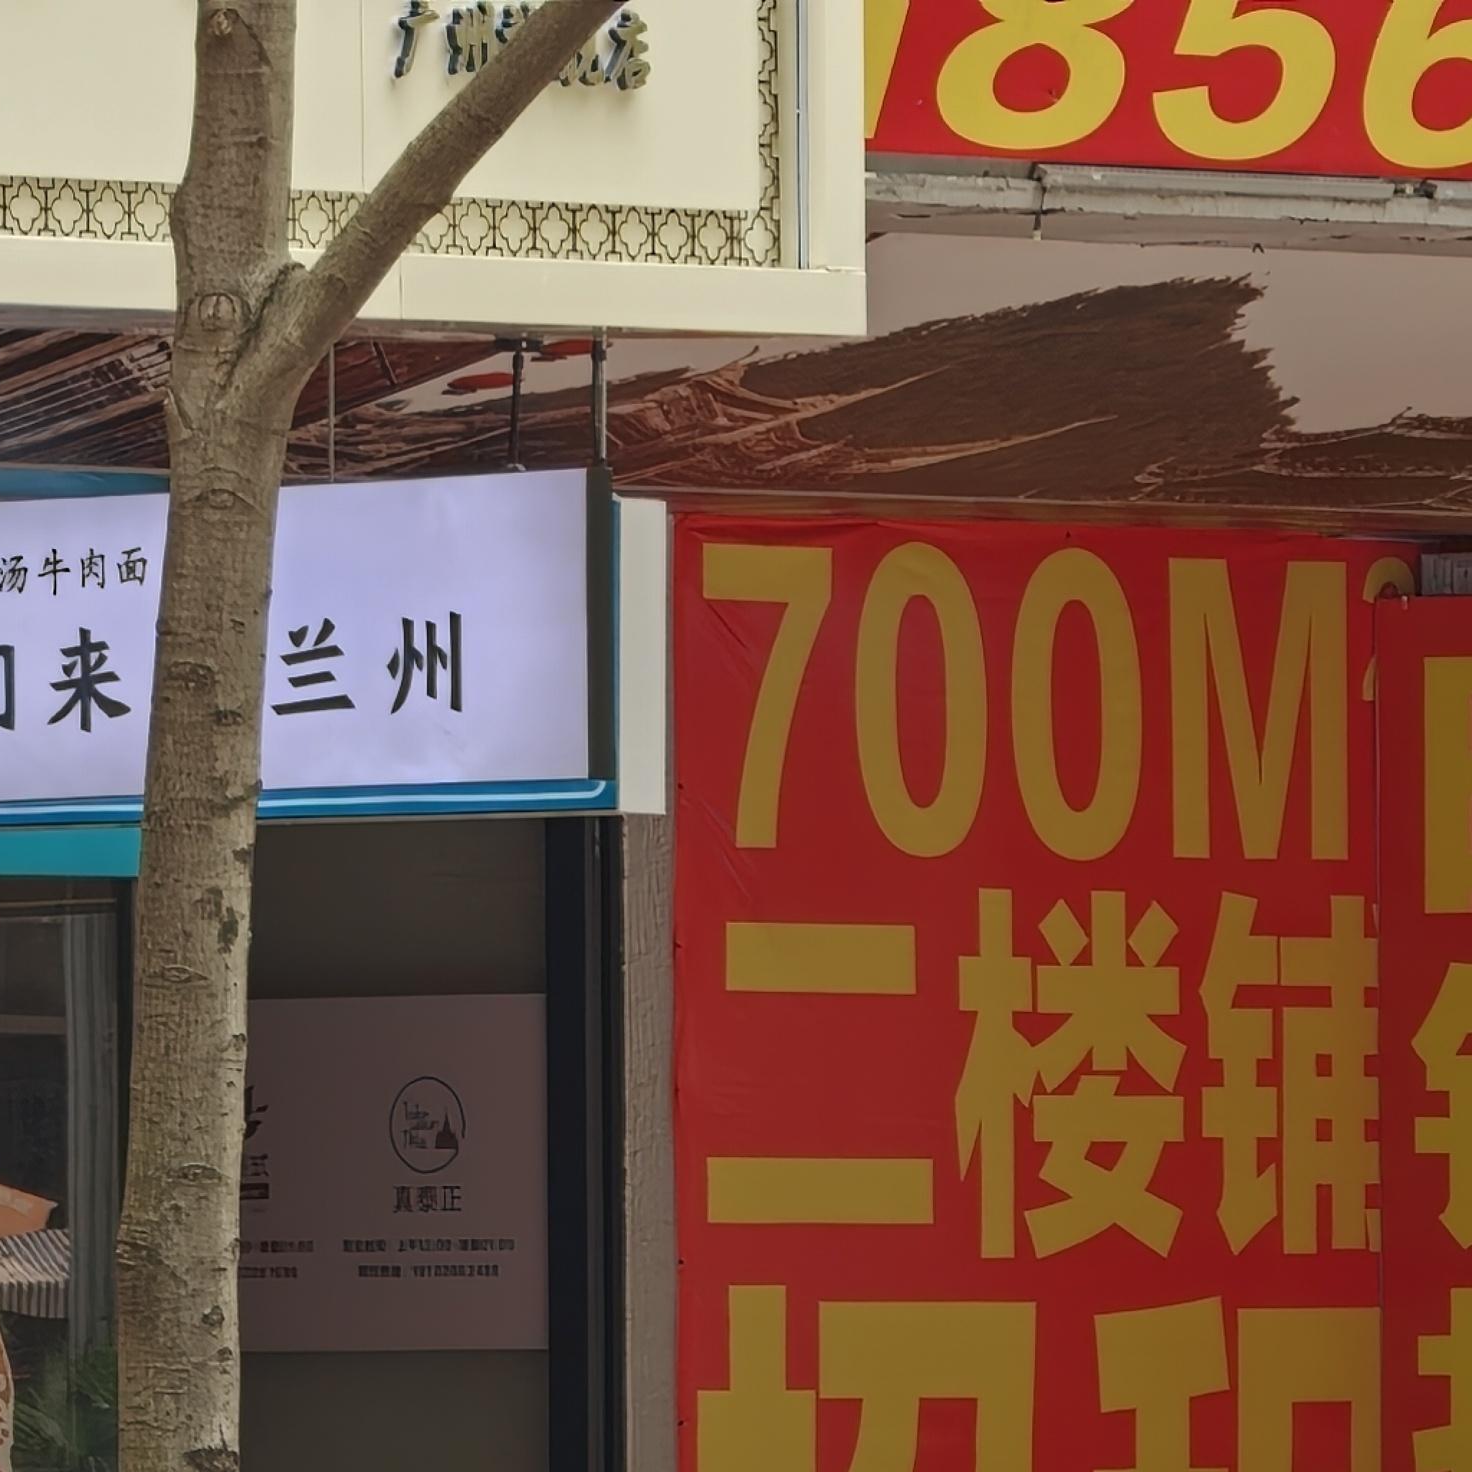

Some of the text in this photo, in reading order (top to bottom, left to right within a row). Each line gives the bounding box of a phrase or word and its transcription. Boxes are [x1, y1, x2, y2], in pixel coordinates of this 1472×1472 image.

[393, 0, 652, 91] 广州店
[704, 887, 1381, 1260] 二楼铺
